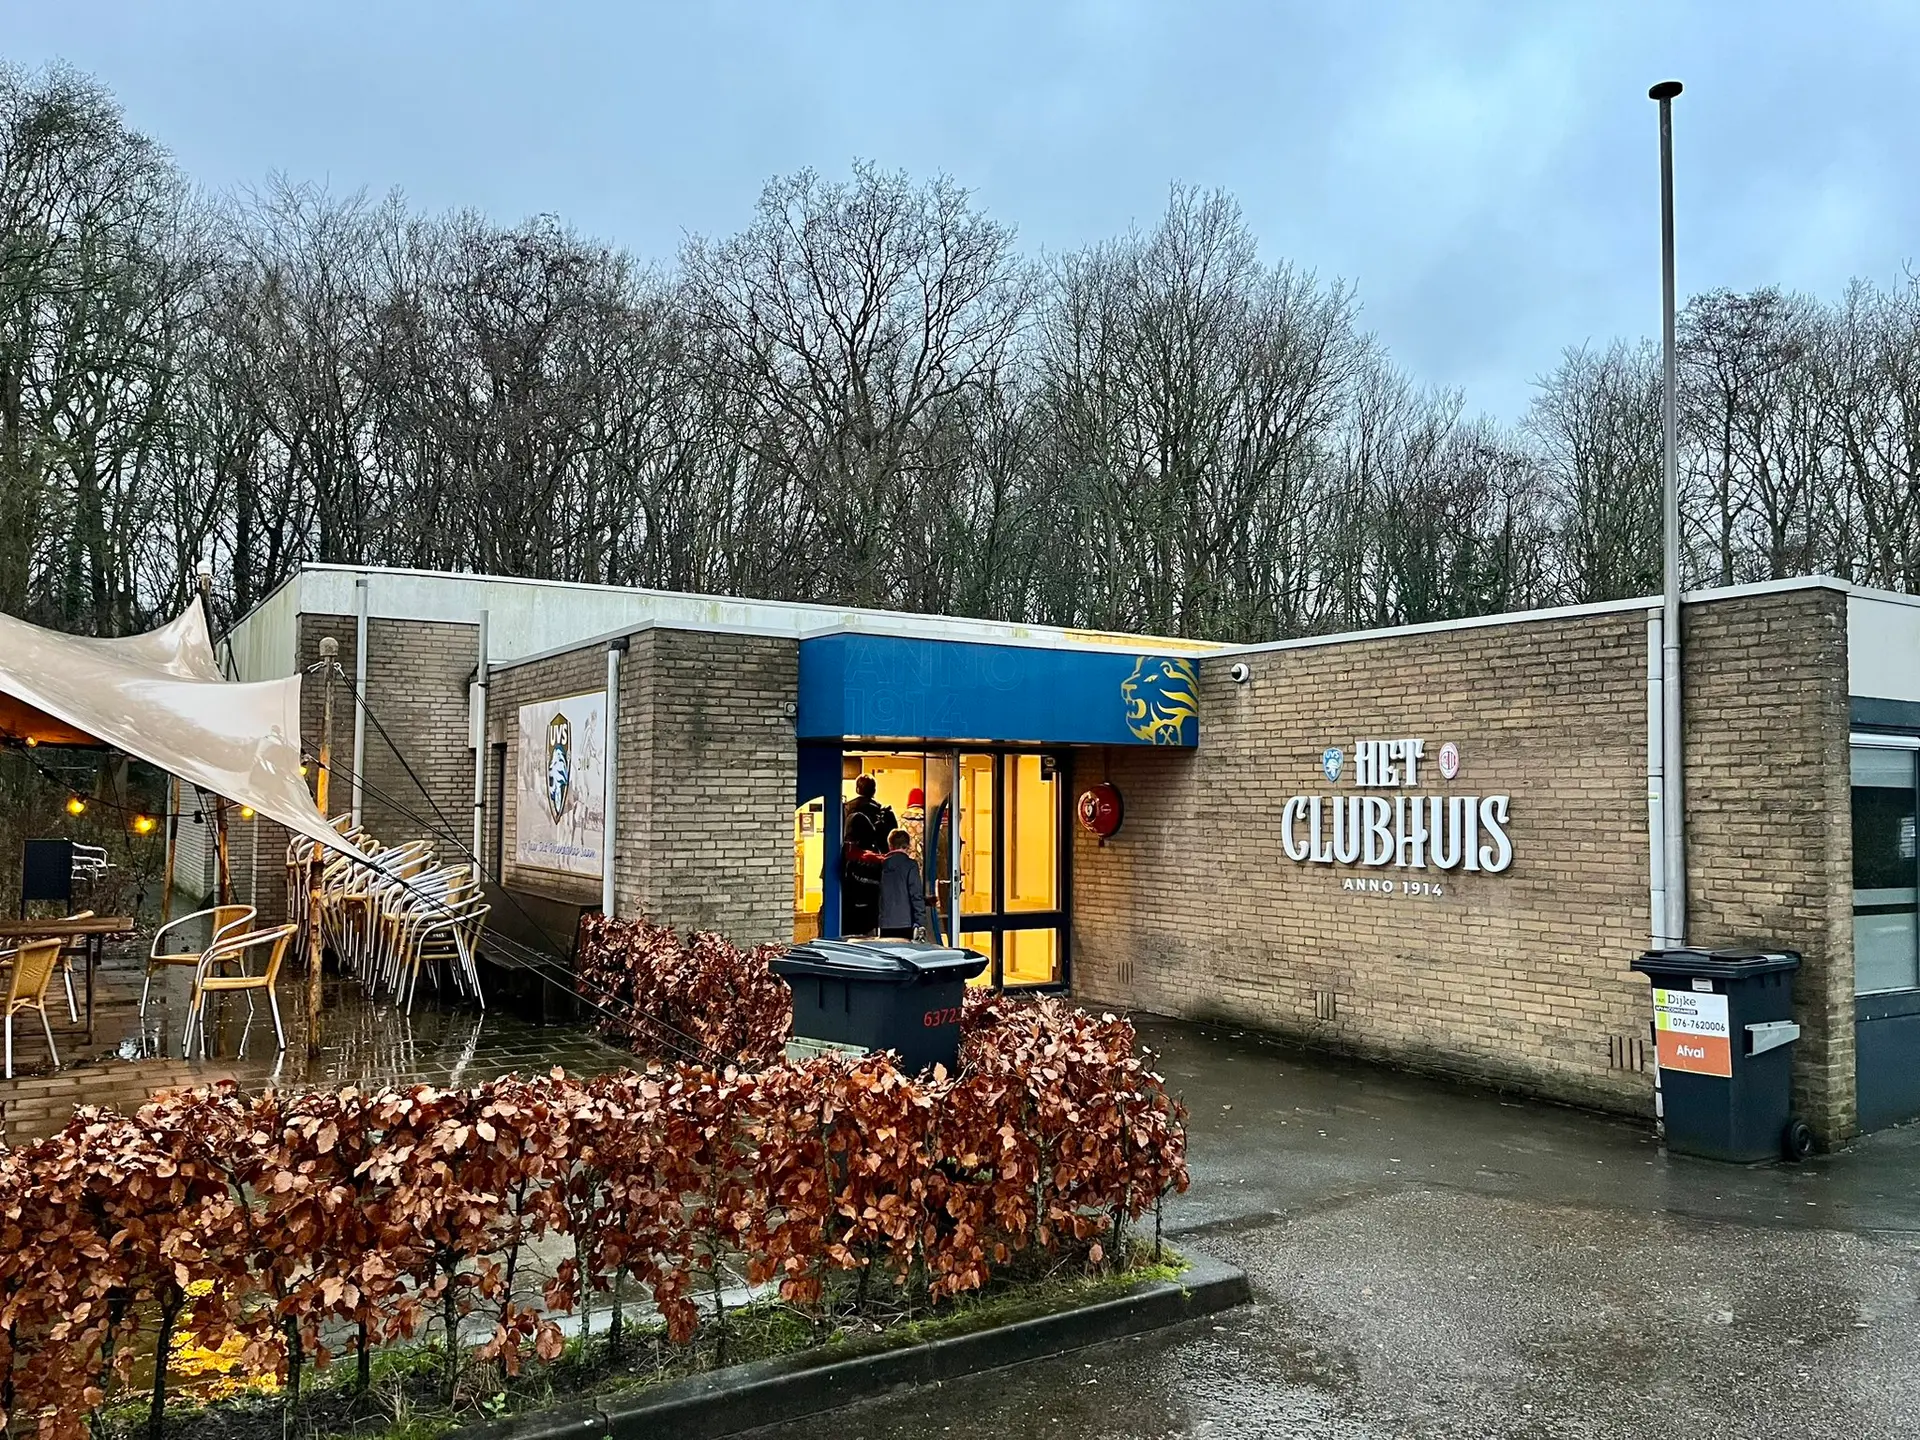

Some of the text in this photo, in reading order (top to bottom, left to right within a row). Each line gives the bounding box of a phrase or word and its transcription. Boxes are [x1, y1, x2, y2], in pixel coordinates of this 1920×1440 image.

[844, 636, 1026, 691] ANNO
[844, 687, 968, 737] 1914
[550, 723, 568, 746] UVS
[1324, 750, 1341, 759] UVS
[1353, 738, 1425, 787] HET
[1281, 795, 1514, 873] CLUBHUIS
[1343, 878, 1443, 897] ANNO 1914
[1667, 994, 1697, 1007] Dijke
[1672, 1017, 1726, 1032] 076-7620006
[1676, 1044, 1705, 1059] Afval
